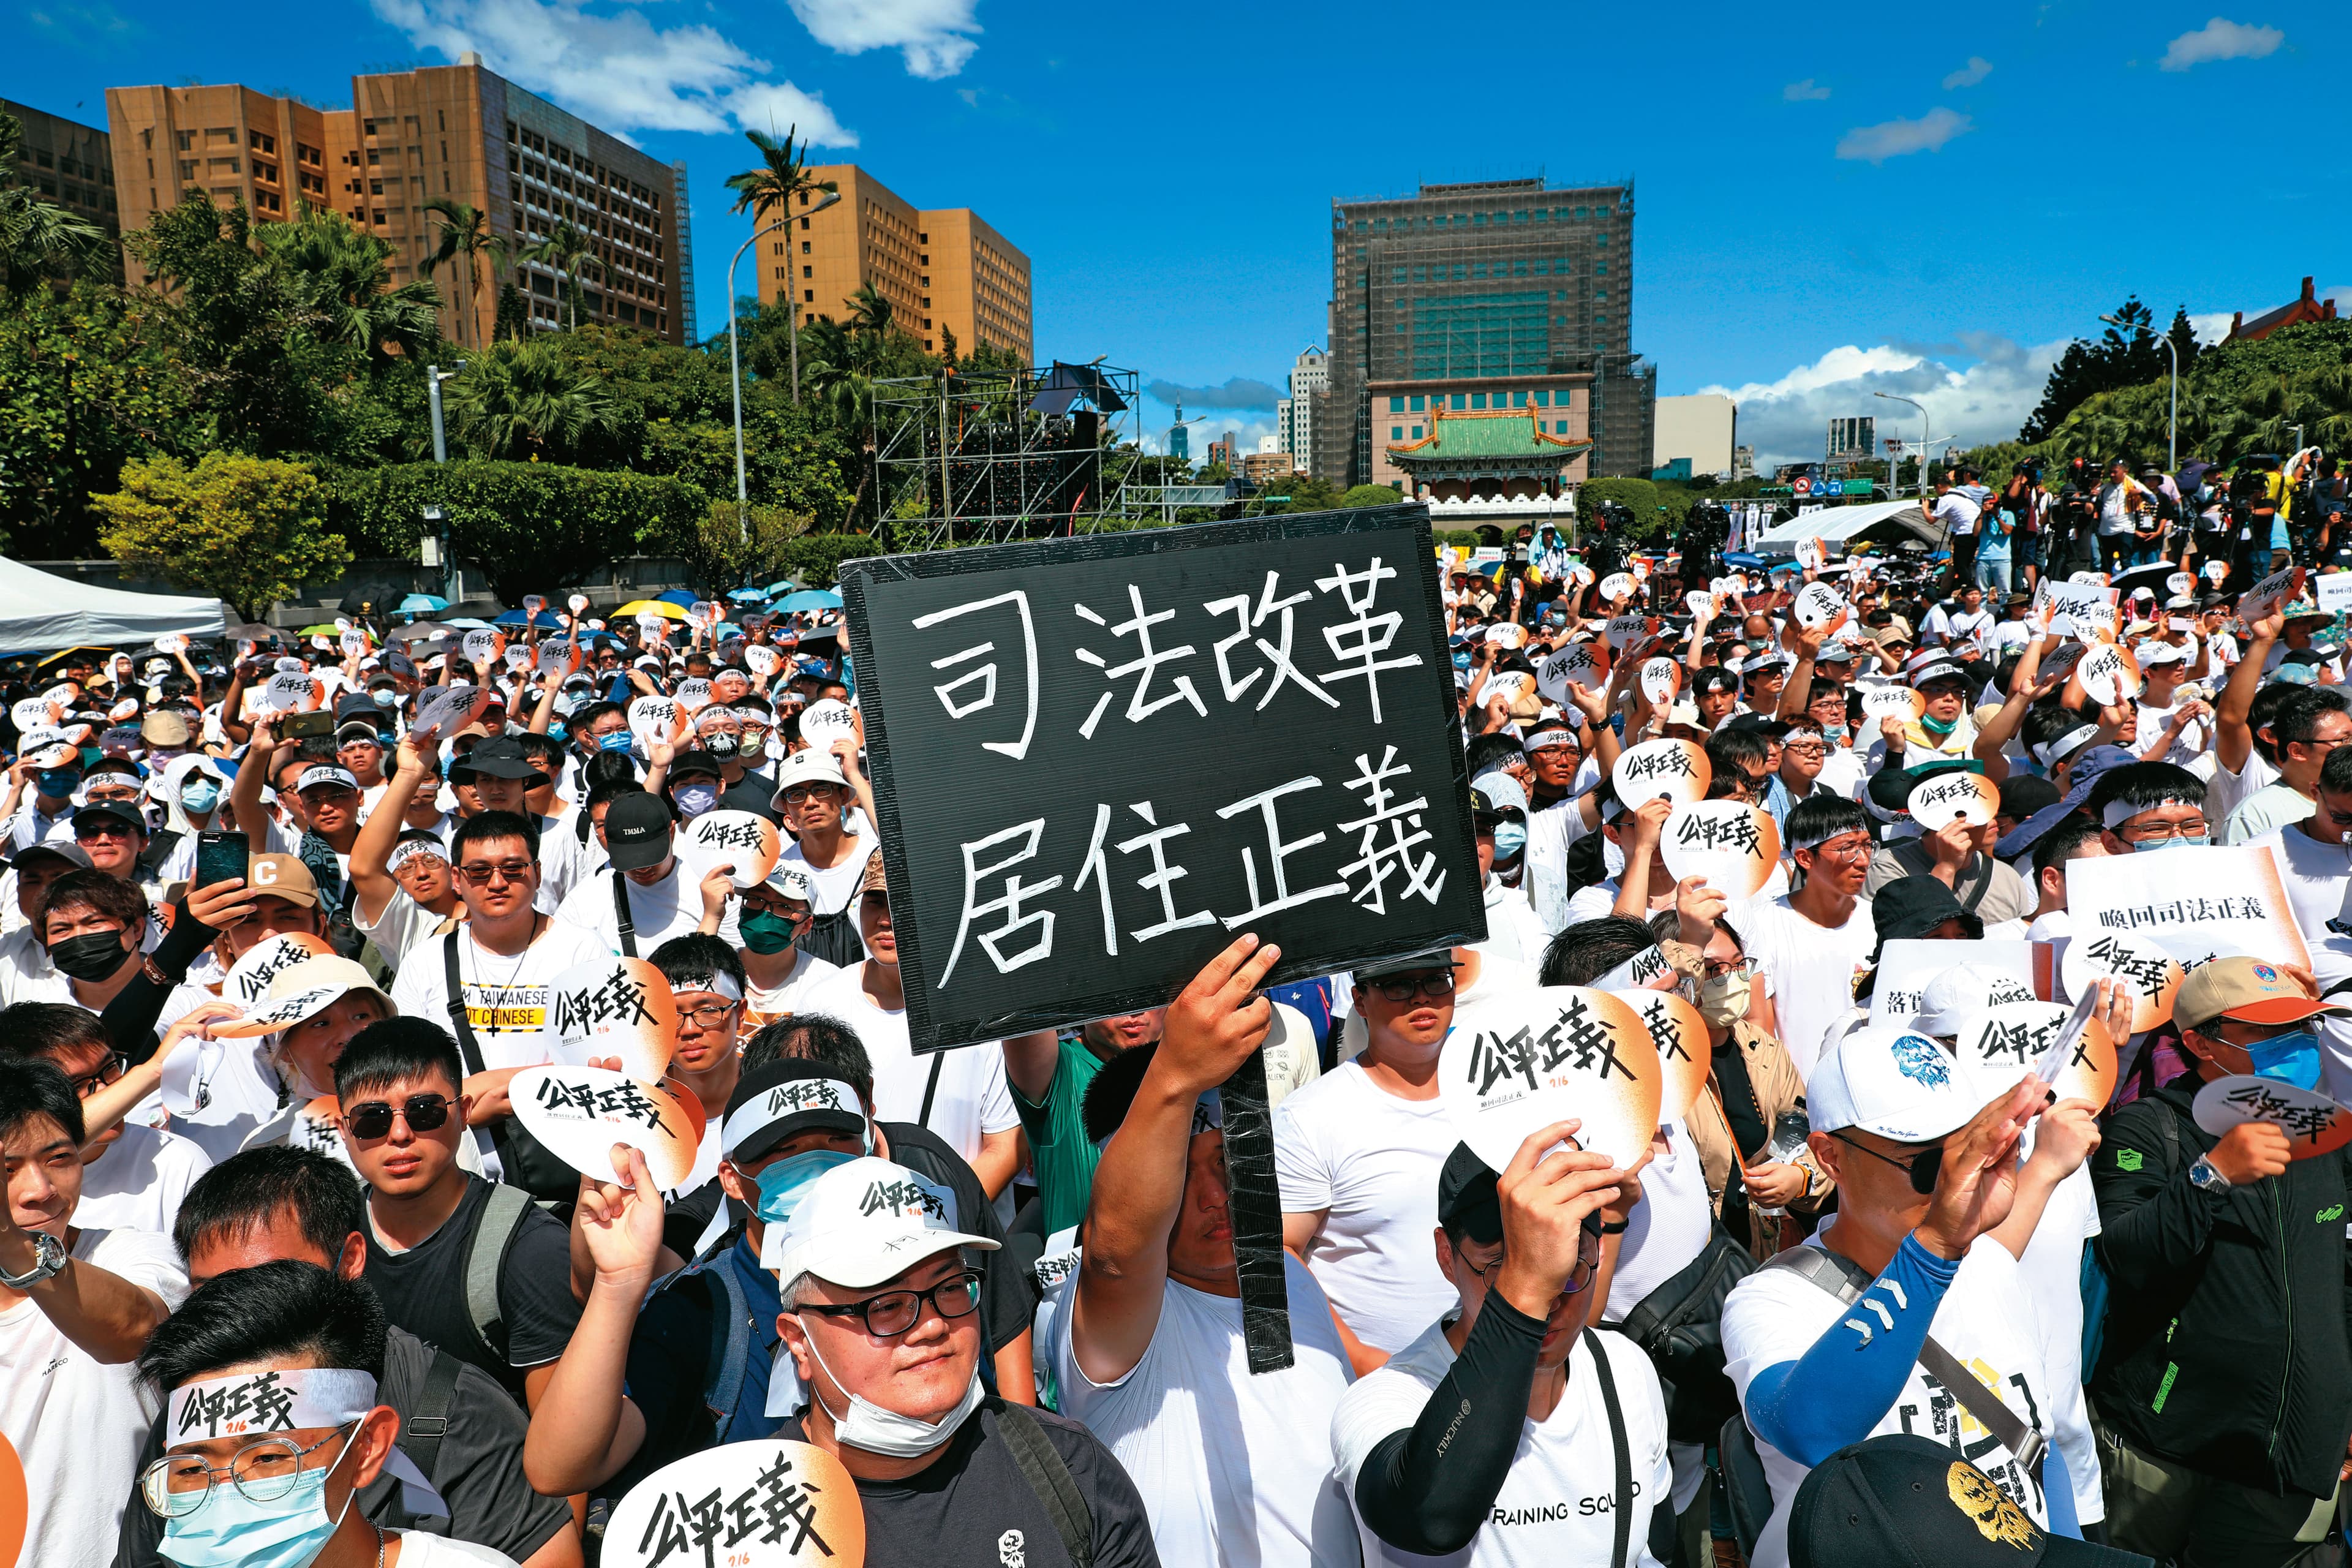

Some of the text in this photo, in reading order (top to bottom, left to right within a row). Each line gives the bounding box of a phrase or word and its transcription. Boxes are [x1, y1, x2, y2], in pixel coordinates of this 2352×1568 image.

[1799, 538, 1820, 552] 公平正義
[1604, 575, 1632, 587] 公平正義
[2250, 571, 2297, 603] 公平正義
[1691, 594, 1716, 609] 公平正義
[1809, 587, 1841, 627] 公平正義
[2094, 605, 2117, 622] 公平正義
[1491, 627, 1521, 639] 公平正義
[1612, 617, 1651, 634] 公平正義
[2068, 617, 2101, 639] 公平正義
[344, 634, 364, 646] 公平正義
[468, 632, 499, 650] 公平正義
[508, 647, 532, 661] 公平正義
[543, 643, 575, 663] 公平正義
[750, 649, 775, 665] 公平正義
[912, 557, 1424, 760] 司法改革
[1545, 645, 1600, 682] 公平正義
[2049, 647, 2082, 666] 公平正義
[2086, 646, 2131, 681] 公平正義
[1646, 661, 1676, 682] 公平正義
[275, 676, 316, 699] 公平正義
[682, 682, 714, 698] 公平正義
[1487, 675, 1526, 692] 公平正義
[1871, 688, 1917, 707] 公平正義
[19, 703, 53, 716] 公平正義
[637, 702, 678, 725] 公平正義
[706, 707, 731, 718] 公平正義
[810, 707, 859, 731] 公平正義
[1547, 731, 1574, 744] 公平正義
[1495, 752, 1523, 771] 公平正義
[1625, 742, 1699, 780] 公平正義
[308, 767, 342, 780] 公平正義
[1920, 775, 1989, 807] 公平正義
[622, 826, 646, 837] TMMA
[697, 818, 767, 858] 公平正義
[1677, 809, 1764, 859] 公平正義
[397, 840, 430, 859] 公平正義
[254, 861, 277, 885] C
[772, 864, 809, 889] 公平正義
[937, 744, 1447, 989] 居住正義
[2098, 896, 2267, 930] 喚回司法正義
[2086, 936, 2173, 1008] 公平正義
[480, 990, 548, 1006] TAIWANESE
[554, 963, 660, 1036] 公平正義
[481, 1008, 535, 1025] CHINESE
[1468, 995, 1638, 1096] 公平正義
[1267, 1072, 1286, 1082] ALIENS
[537, 1077, 673, 1139] 公平正義
[767, 1078, 843, 1117] 公平正義
[2226, 1085, 2337, 1145] 公平正義
[859, 1180, 950, 1224] 公平正義
[42, 1357, 69, 1377] HARECO
[178, 1371, 298, 1437] 公平正義
[225, 1420, 247, 1434] 7.16
[1436, 1411, 1465, 1458] NUCKILY
[638, 1450, 834, 1568] 公平正義
[1578, 1480, 1641, 1517] SQUD
[728, 1551, 750, 1568] 7.16
